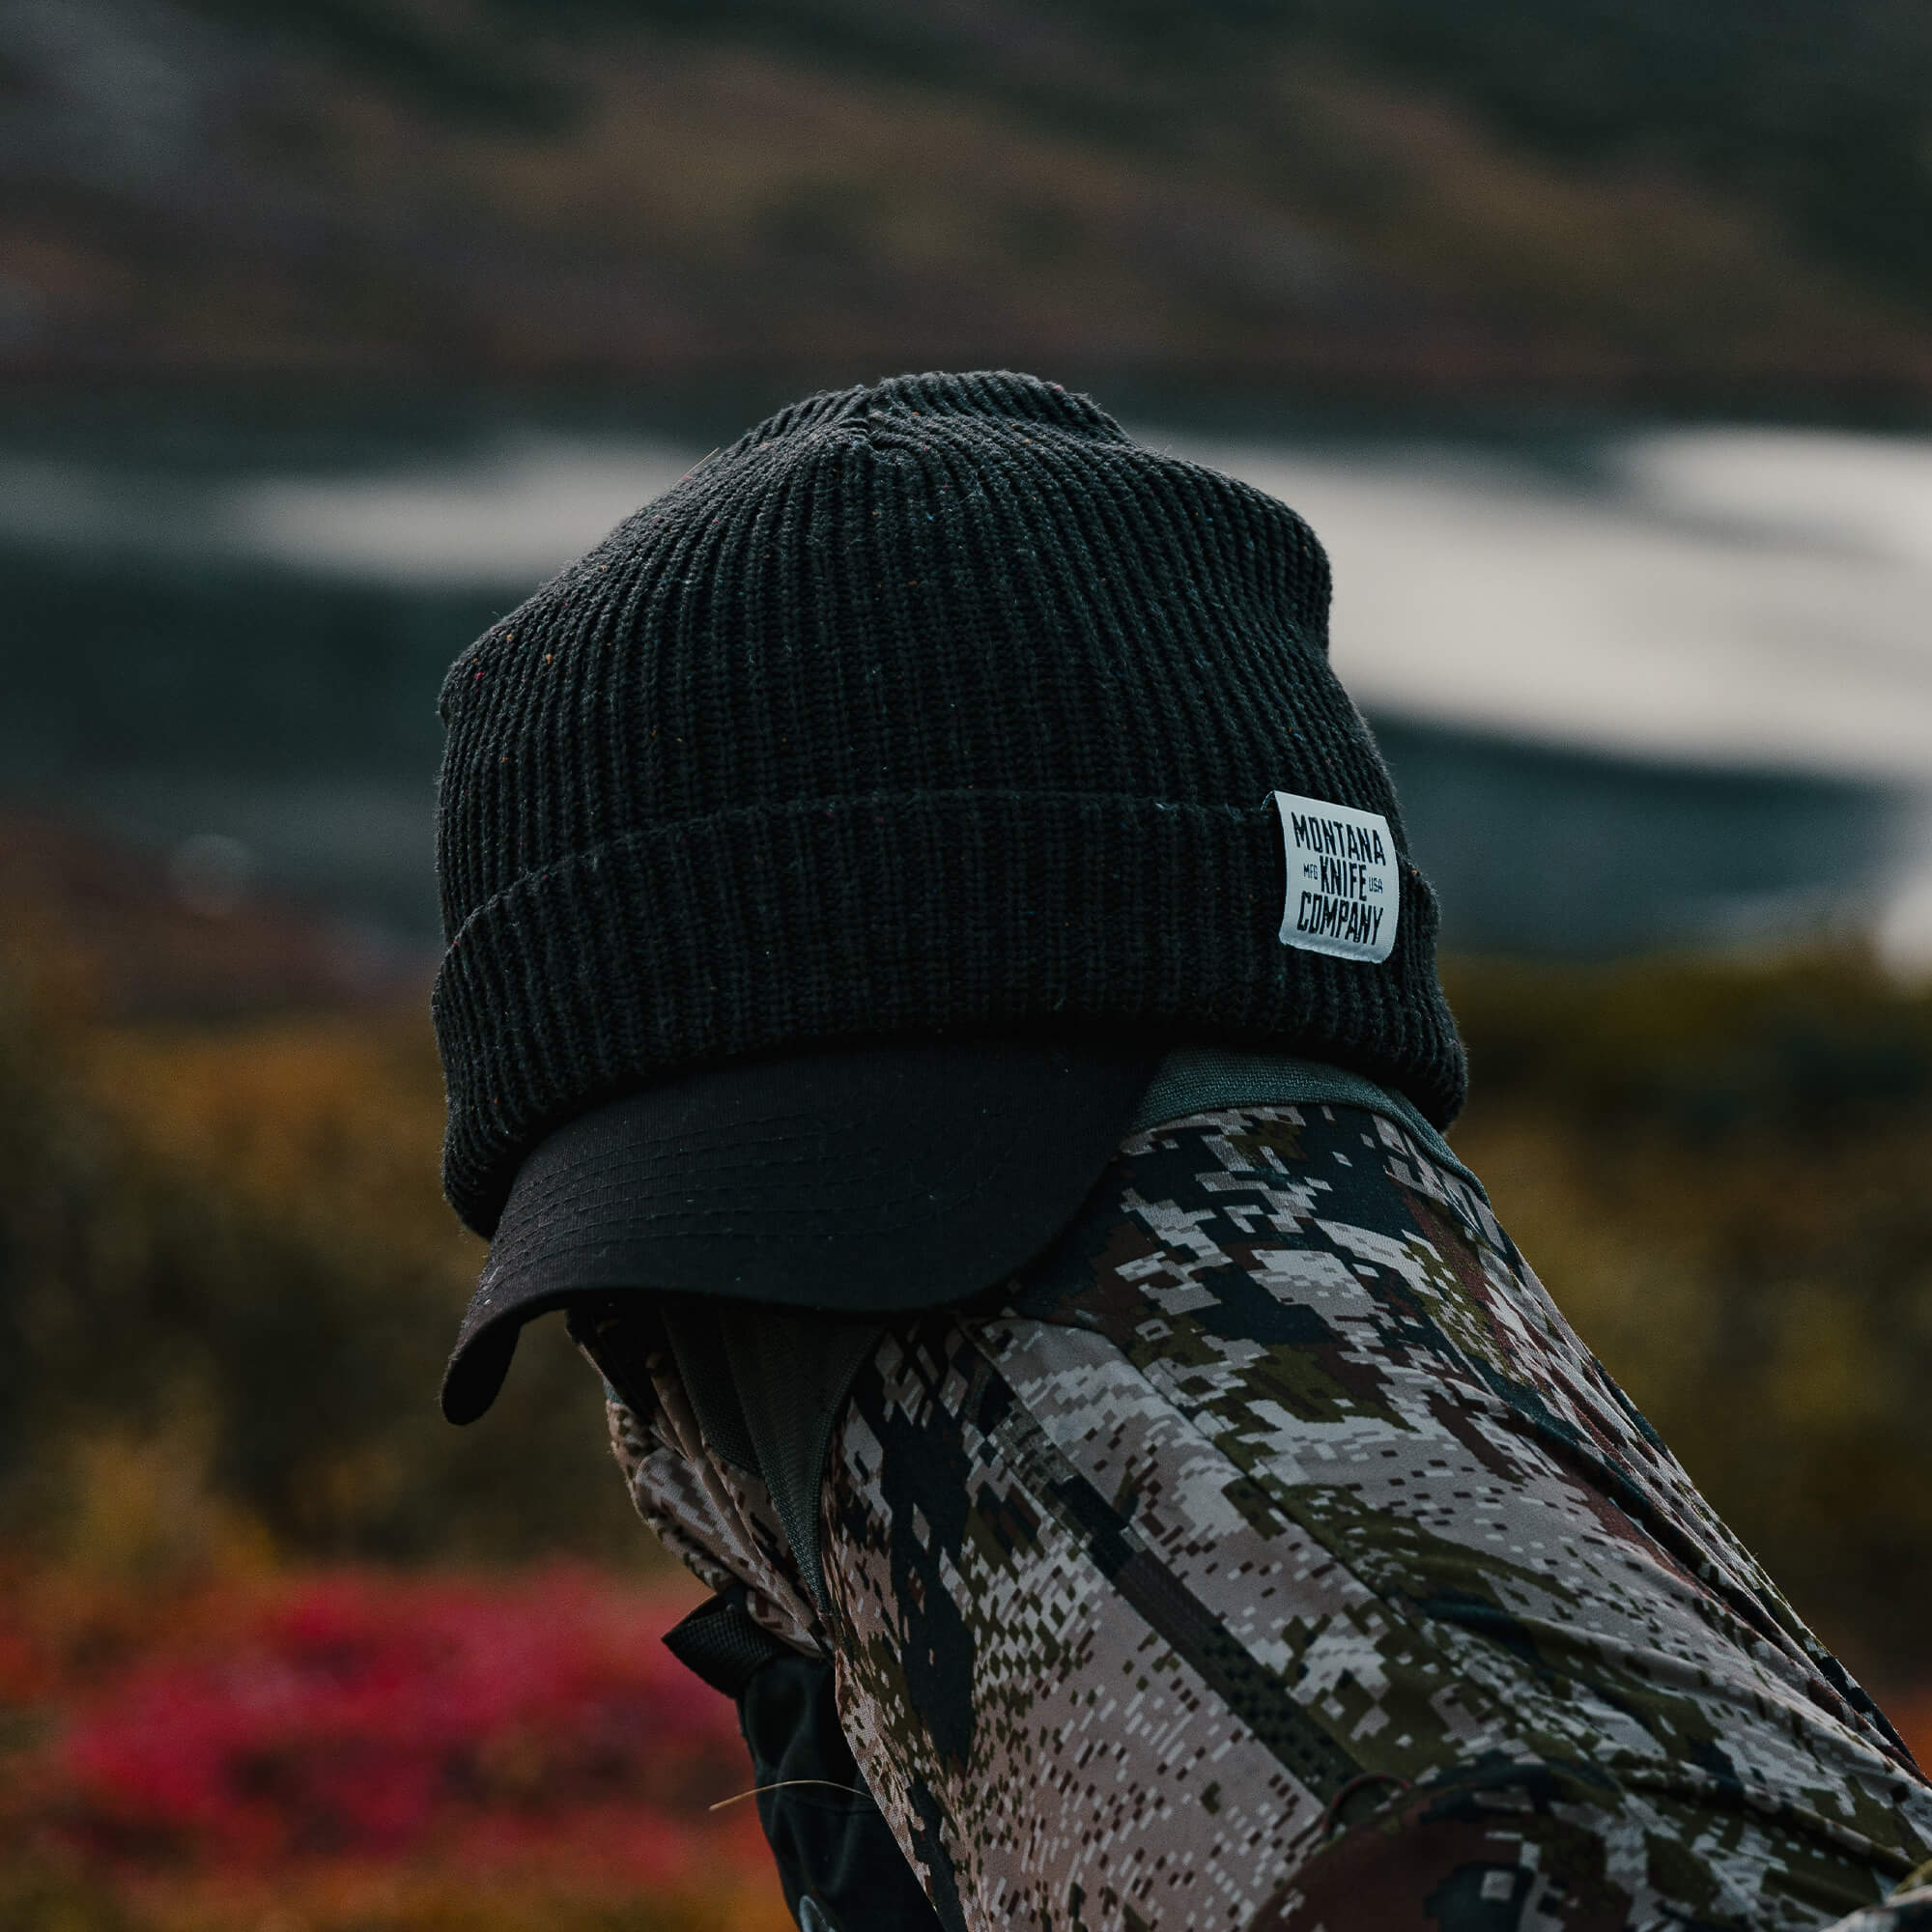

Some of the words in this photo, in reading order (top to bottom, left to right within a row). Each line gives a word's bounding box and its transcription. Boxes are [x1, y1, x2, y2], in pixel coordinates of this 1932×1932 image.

[1291, 811, 1386, 866] MONTANA
[1303, 864, 1319, 880] MFG
[1320, 855, 1367, 901] KNIFE
[1368, 877, 1383, 894] USA
[1296, 891, 1383, 946] COMPANY
